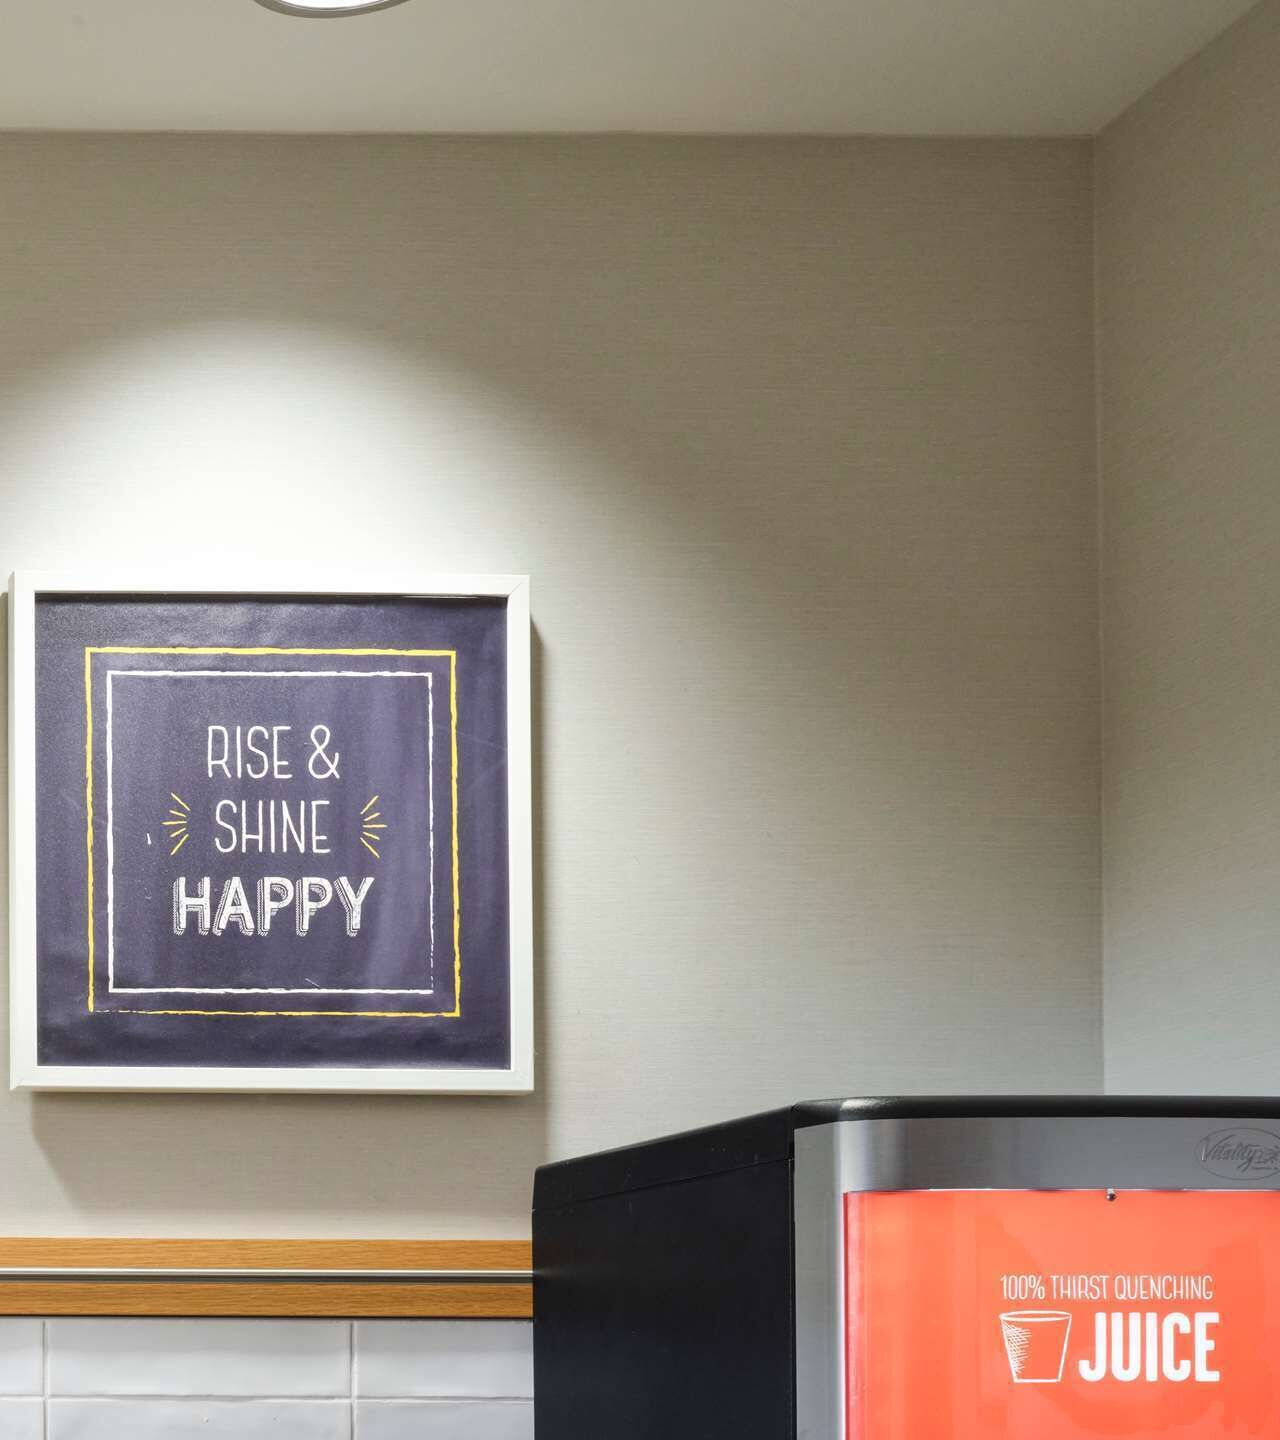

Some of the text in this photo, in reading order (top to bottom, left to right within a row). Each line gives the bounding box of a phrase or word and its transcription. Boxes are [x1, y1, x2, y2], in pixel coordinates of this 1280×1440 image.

[207, 724, 340, 779] RISE &
[214, 800, 331, 855] SHINE
[172, 876, 375, 937] HAPPY
[999, 1274, 1213, 1300] 100% THIRST QUENCHING
[1078, 1311, 1220, 1382] JUICE
